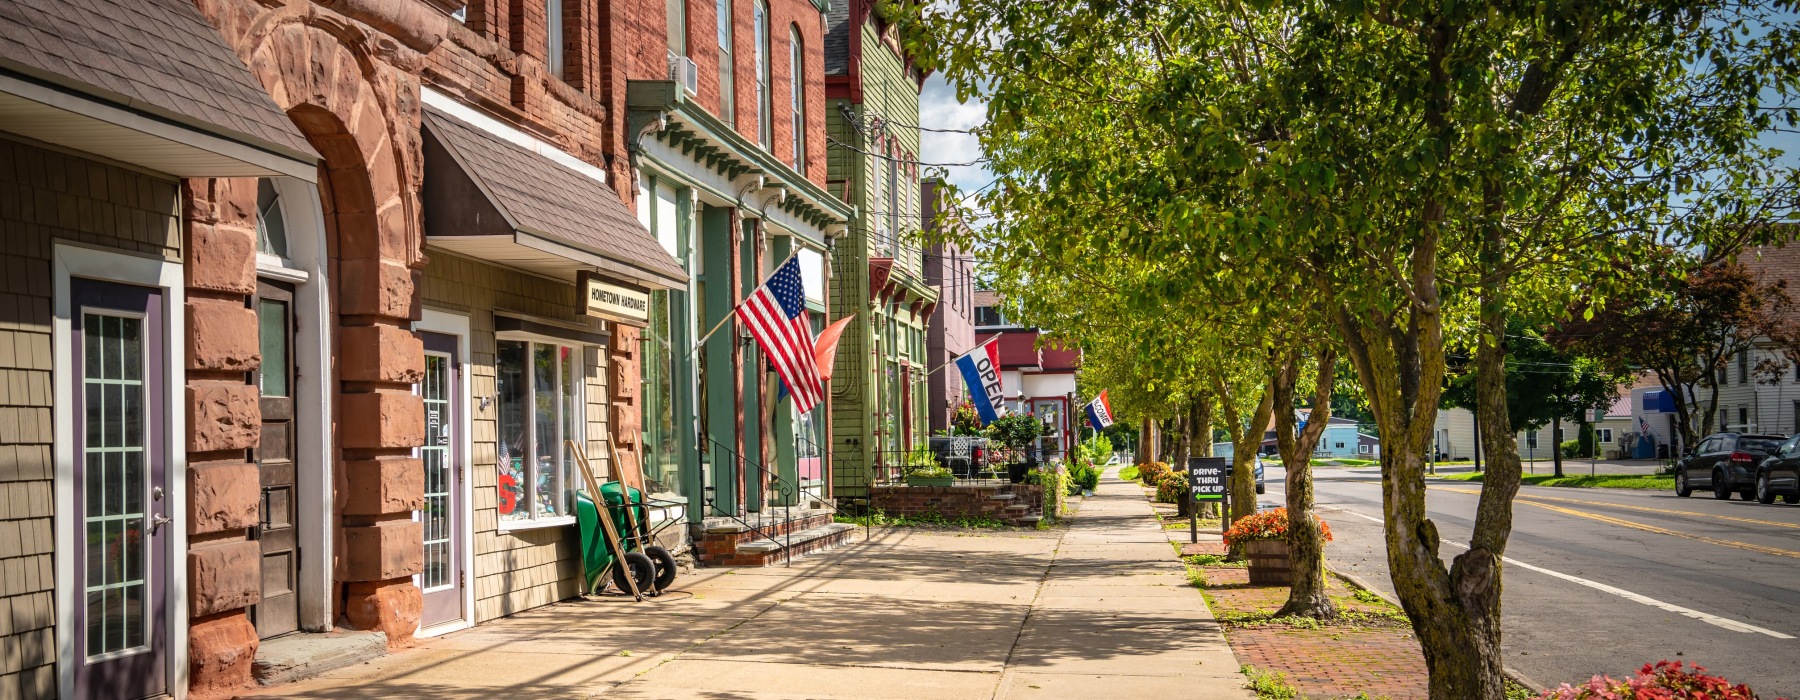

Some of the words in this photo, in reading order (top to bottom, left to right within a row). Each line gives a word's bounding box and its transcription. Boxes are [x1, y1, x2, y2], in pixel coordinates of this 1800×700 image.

[591, 287, 620, 306] HOMETOWN
[621, 295, 646, 312] HARDWARE
[976, 357, 1004, 410] OPEN
